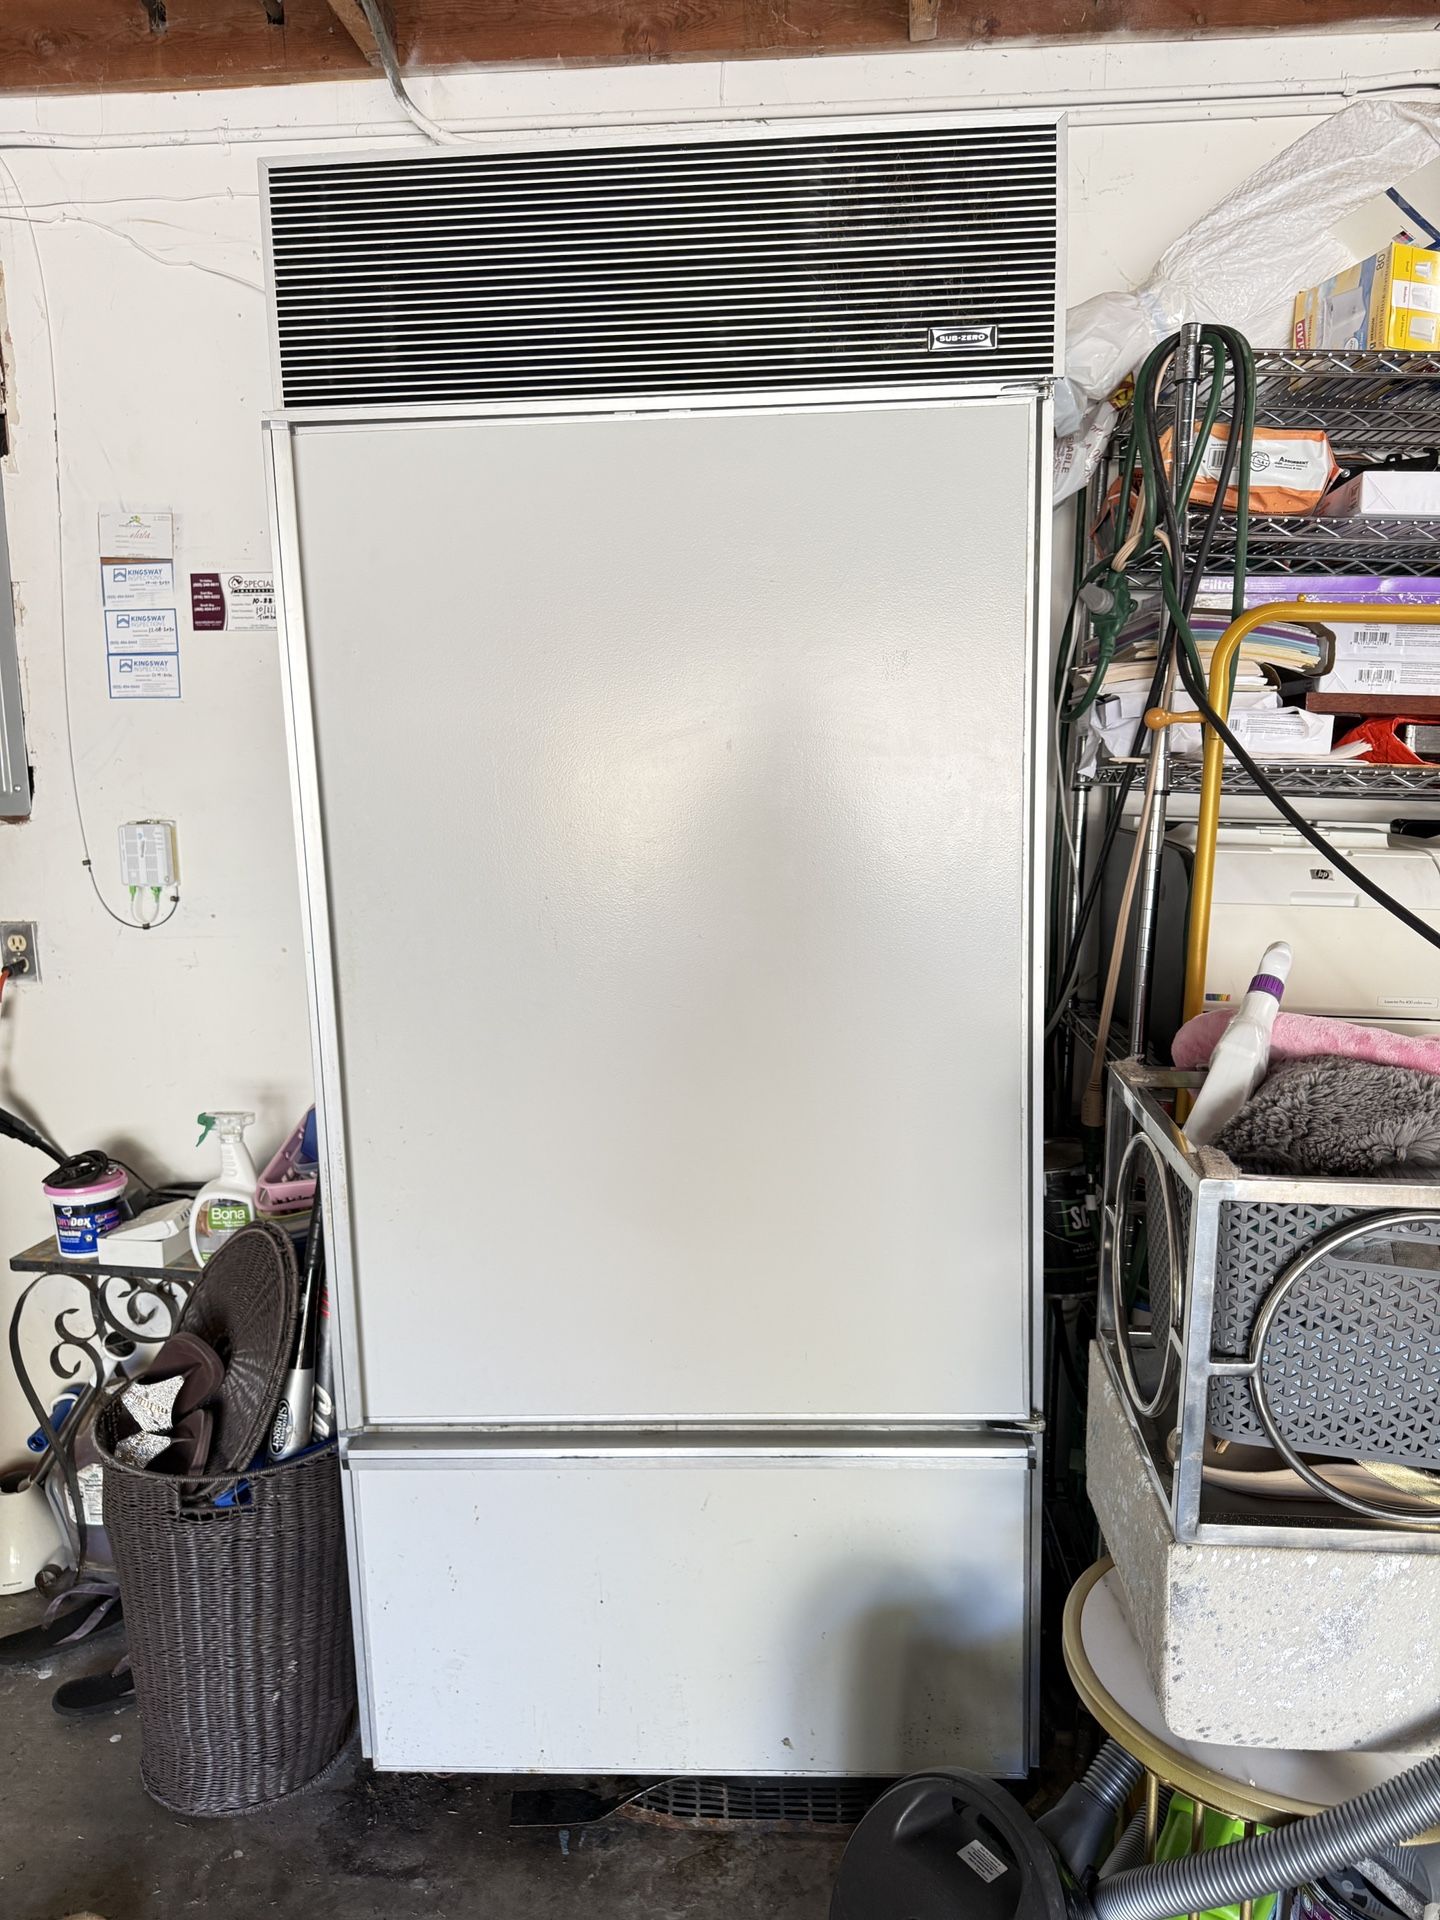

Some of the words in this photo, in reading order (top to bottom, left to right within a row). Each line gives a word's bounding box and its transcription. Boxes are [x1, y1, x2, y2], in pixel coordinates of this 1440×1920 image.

[1376, 254, 1386, 271] 80
[128, 568, 163, 576] KINGSWAY
[211, 1207, 246, 1220] Bona
